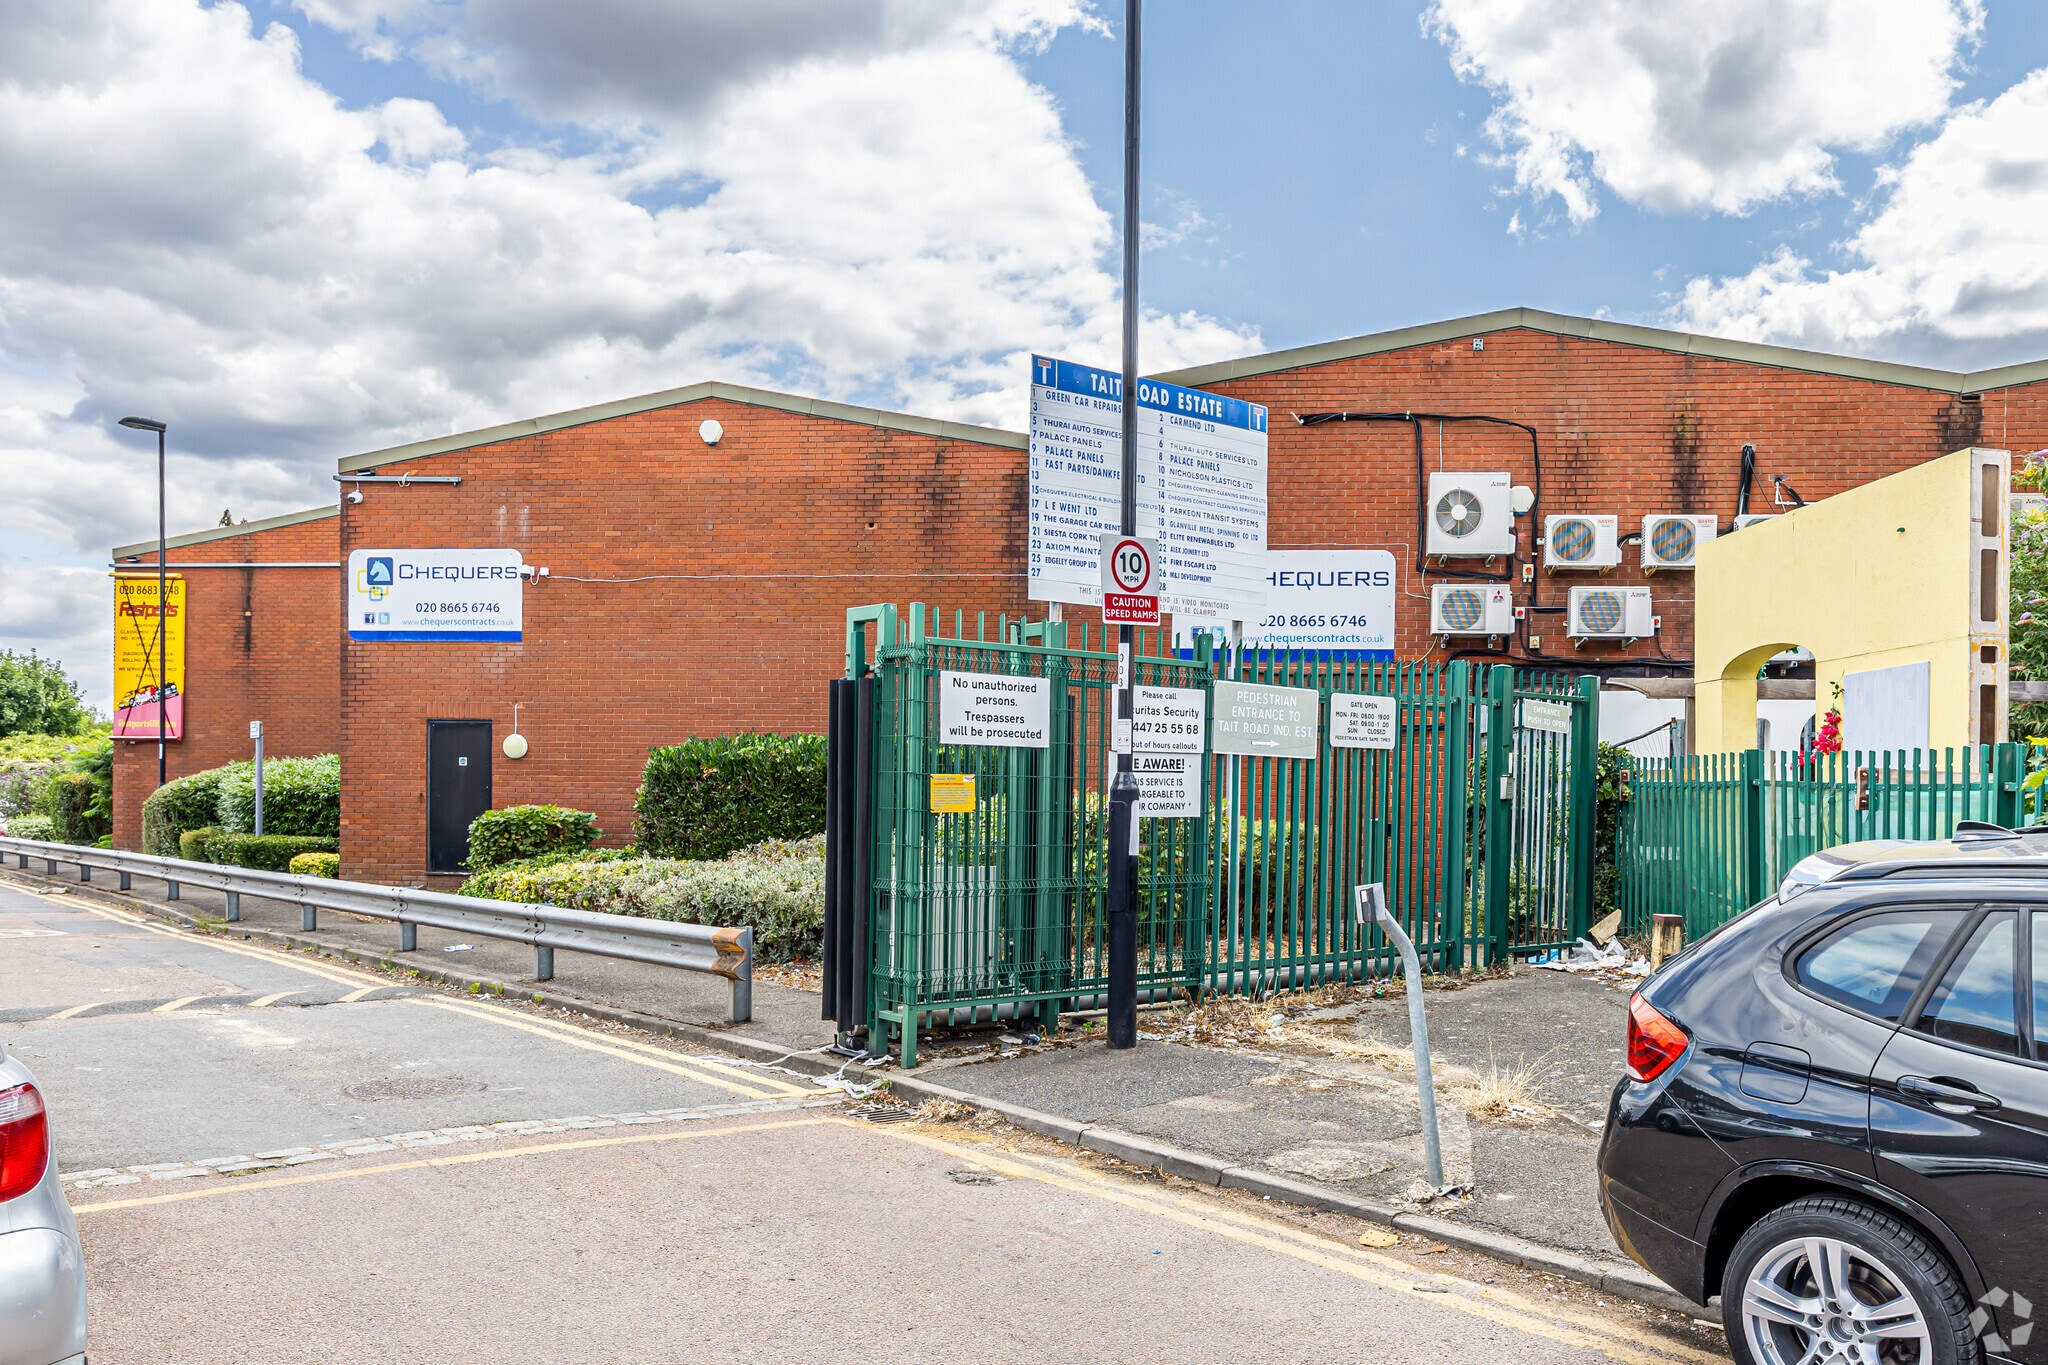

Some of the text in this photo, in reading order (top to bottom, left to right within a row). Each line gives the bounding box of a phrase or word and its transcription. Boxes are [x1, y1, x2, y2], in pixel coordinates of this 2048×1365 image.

[1046, 390, 1122, 414] GREEN CAR REPAIRS
[1091, 374, 1222, 418] TAIT OAD ESTATE
[1033, 402, 1038, 411] 3
[1032, 416, 1122, 439] 5 THURAI AUTO SERVICES
[1160, 414, 1215, 432] 2 CARMEND LTD
[1159, 427, 1163, 435] 4
[1032, 430, 1102, 448] 7 PALACE PANELS
[1032, 444, 1104, 463] 9 PALACE PANELS
[1170, 443, 1194, 453] THURAI
[1215, 451, 1246, 463] SERVICES
[1247, 458, 1258, 466] LTD
[1032, 458, 1063, 470] 11 FAST
[1159, 452, 1220, 472] 8 PALACE PANELS
[1032, 471, 1039, 480] 13
[1158, 466, 1165, 474] 10
[1170, 468, 1209, 481] NICHOLSON
[1212, 476, 1241, 487] PLASTICS
[1032, 485, 1098, 501] 15 CHEQUERS ELECTRICAL
[1158, 479, 1165, 487] 12
[1168, 481, 1192, 490] CHEQUERS
[1193, 486, 1217, 495] CONTRACT
[1158, 491, 1165, 499] 14
[1032, 499, 1097, 516] 17 WENT LTD
[1032, 512, 1102, 529] 19 THE GARAGE CAR
[1158, 505, 1259, 528] 16 PARKEON TRANSIT SYSTEMS
[1032, 526, 1087, 540] 21 SIESTA CORK
[1158, 518, 1165, 526] 18
[1170, 521, 1196, 531] GLANVILLE
[1200, 527, 1214, 535] METAL
[1217, 528, 1240, 538] SPINNING
[1159, 531, 1166, 540] 20
[1187, 536, 1223, 546] RENEWABLES
[1032, 540, 1070, 553] 23 AXIOM
[1159, 543, 1166, 552] 22
[1182, 548, 1200, 556] JOINERY
[1032, 554, 1040, 562] 25
[1045, 556, 1067, 566] EDGELEY
[1069, 559, 1087, 568] GROUP
[1120, 552, 1142, 574] 10
[1159, 556, 1166, 564] 24
[1171, 559, 1182, 567] FIRE
[1184, 560, 1205, 569] ESCAPE
[399, 564, 517, 582] CHEQUERS
[1032, 568, 1040, 576] 27
[1159, 569, 1166, 577] 26
[1181, 572, 1211, 583] DEVELOPMENT
[1159, 582, 1166, 591] 28
[1266, 571, 1390, 590] HEQUERS
[119, 585, 158, 595] 020 8683
[416, 603, 500, 612] 020 8665 6746
[1112, 597, 1151, 608] CAUTION
[1200, 600, 1229, 609] MONITORED
[1105, 609, 1158, 620] SPEED RAMPS
[1290, 615, 1367, 627] 8665 6746
[401, 618, 514, 627] www.chequerscontracts.co.uk
[952, 678, 1037, 693] No unauthorized
[976, 696, 1018, 706] persons.
[1142, 691, 1163, 699] Please
[1237, 691, 1297, 707] PEDESTRIAN
[965, 711, 1024, 724] Trespassers
[1164, 707, 1199, 719] Security
[1232, 706, 1300, 722] ENTRANCE TO
[1534, 706, 1561, 717] ENTRANCE
[1155, 723, 1198, 734] 25 55 68
[1528, 716, 1541, 724] PUSH
[1552, 719, 1566, 728] OPEN
[950, 726, 1041, 739] will be prosecuted
[1218, 720, 1313, 738] TAIT ROAD IND. EST.
[1143, 758, 1185, 769] AWARE!
[1146, 778, 1174, 786] SERVICE
[1148, 802, 1186, 810] COMPANY
